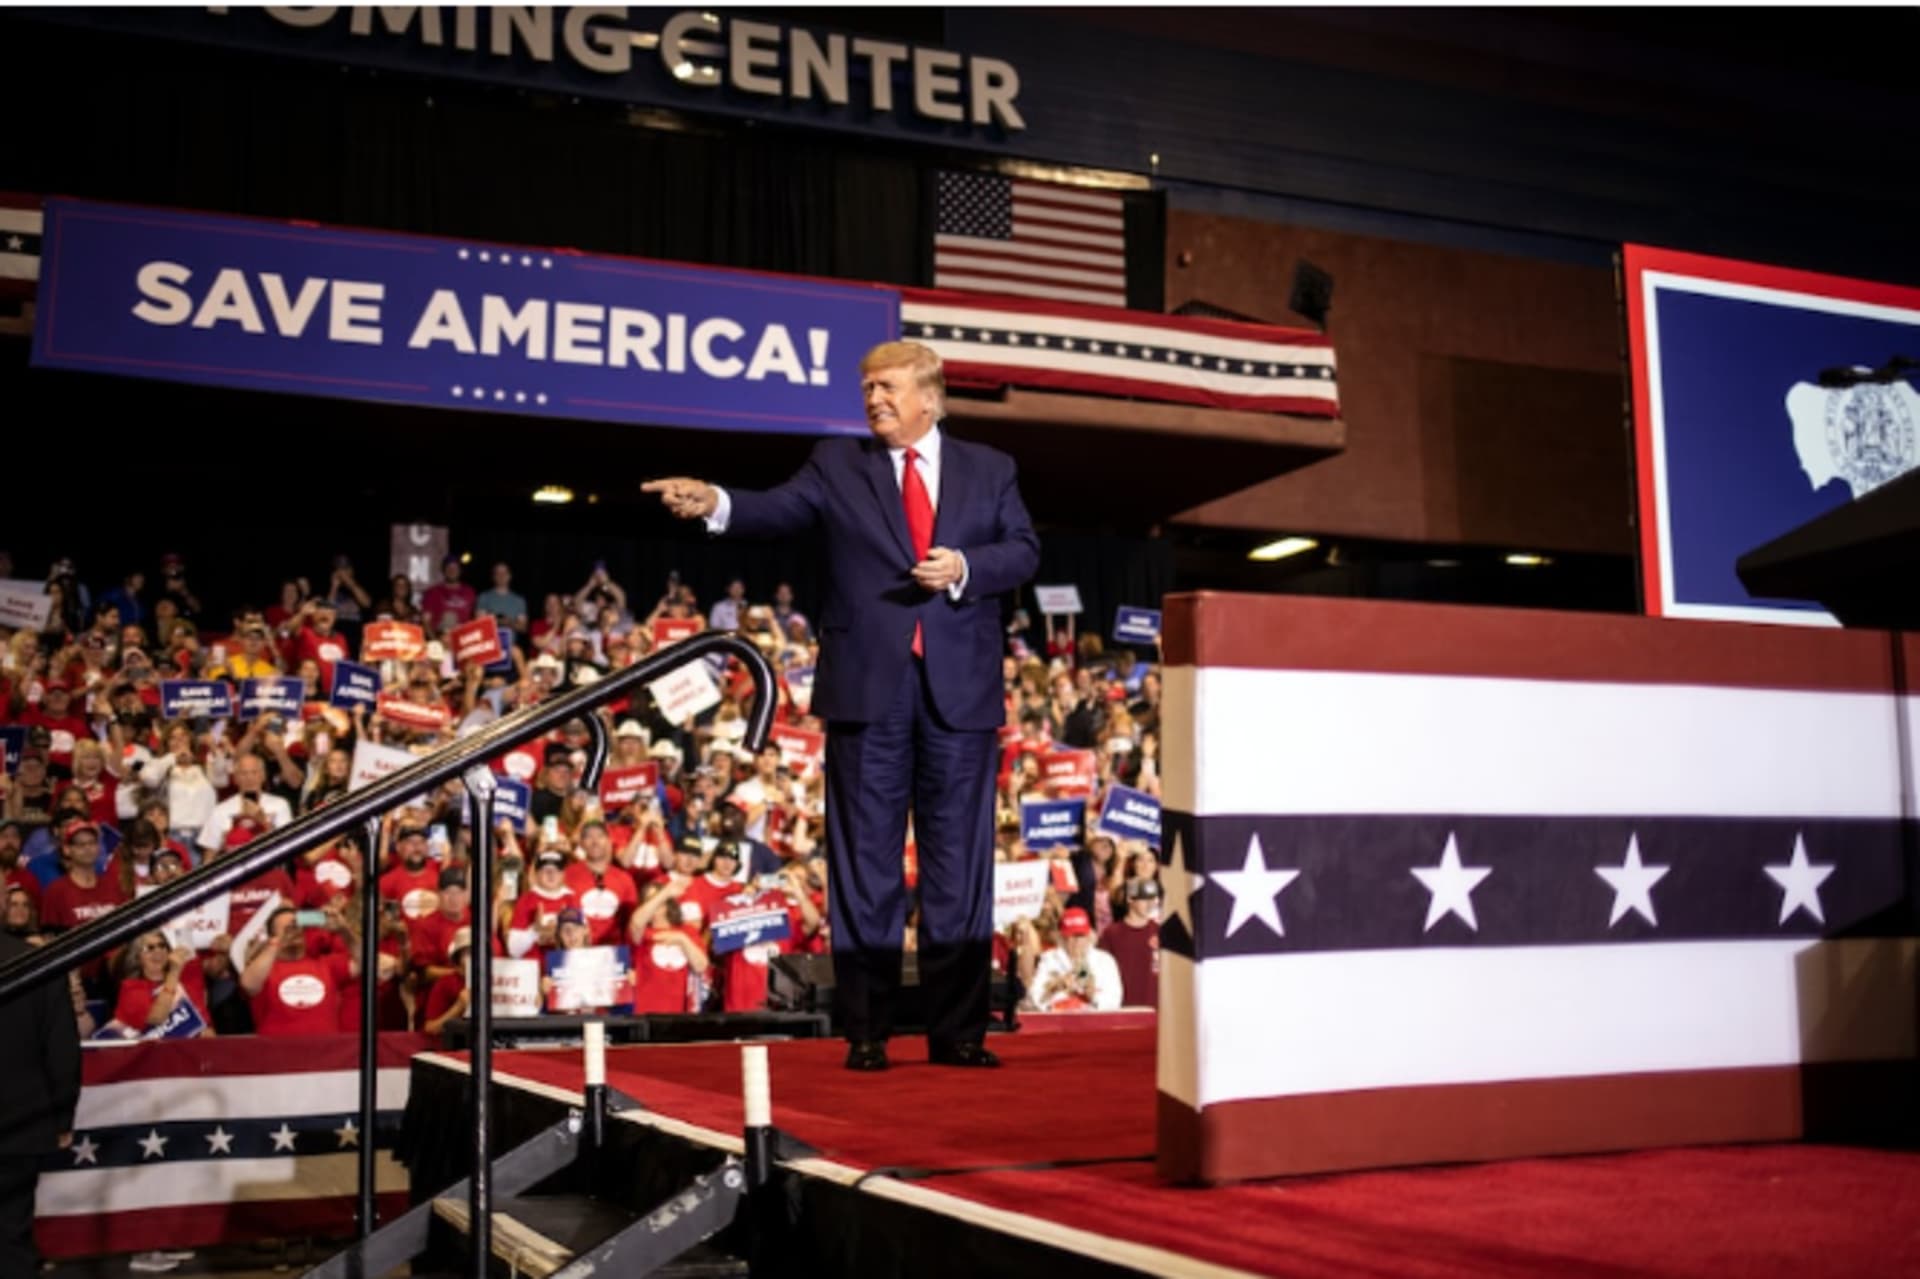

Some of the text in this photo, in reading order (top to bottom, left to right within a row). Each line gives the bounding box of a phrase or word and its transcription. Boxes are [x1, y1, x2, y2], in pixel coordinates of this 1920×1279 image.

[660, 12, 1026, 129] CENTER
[131, 261, 830, 386] SAVE AMERICA!
